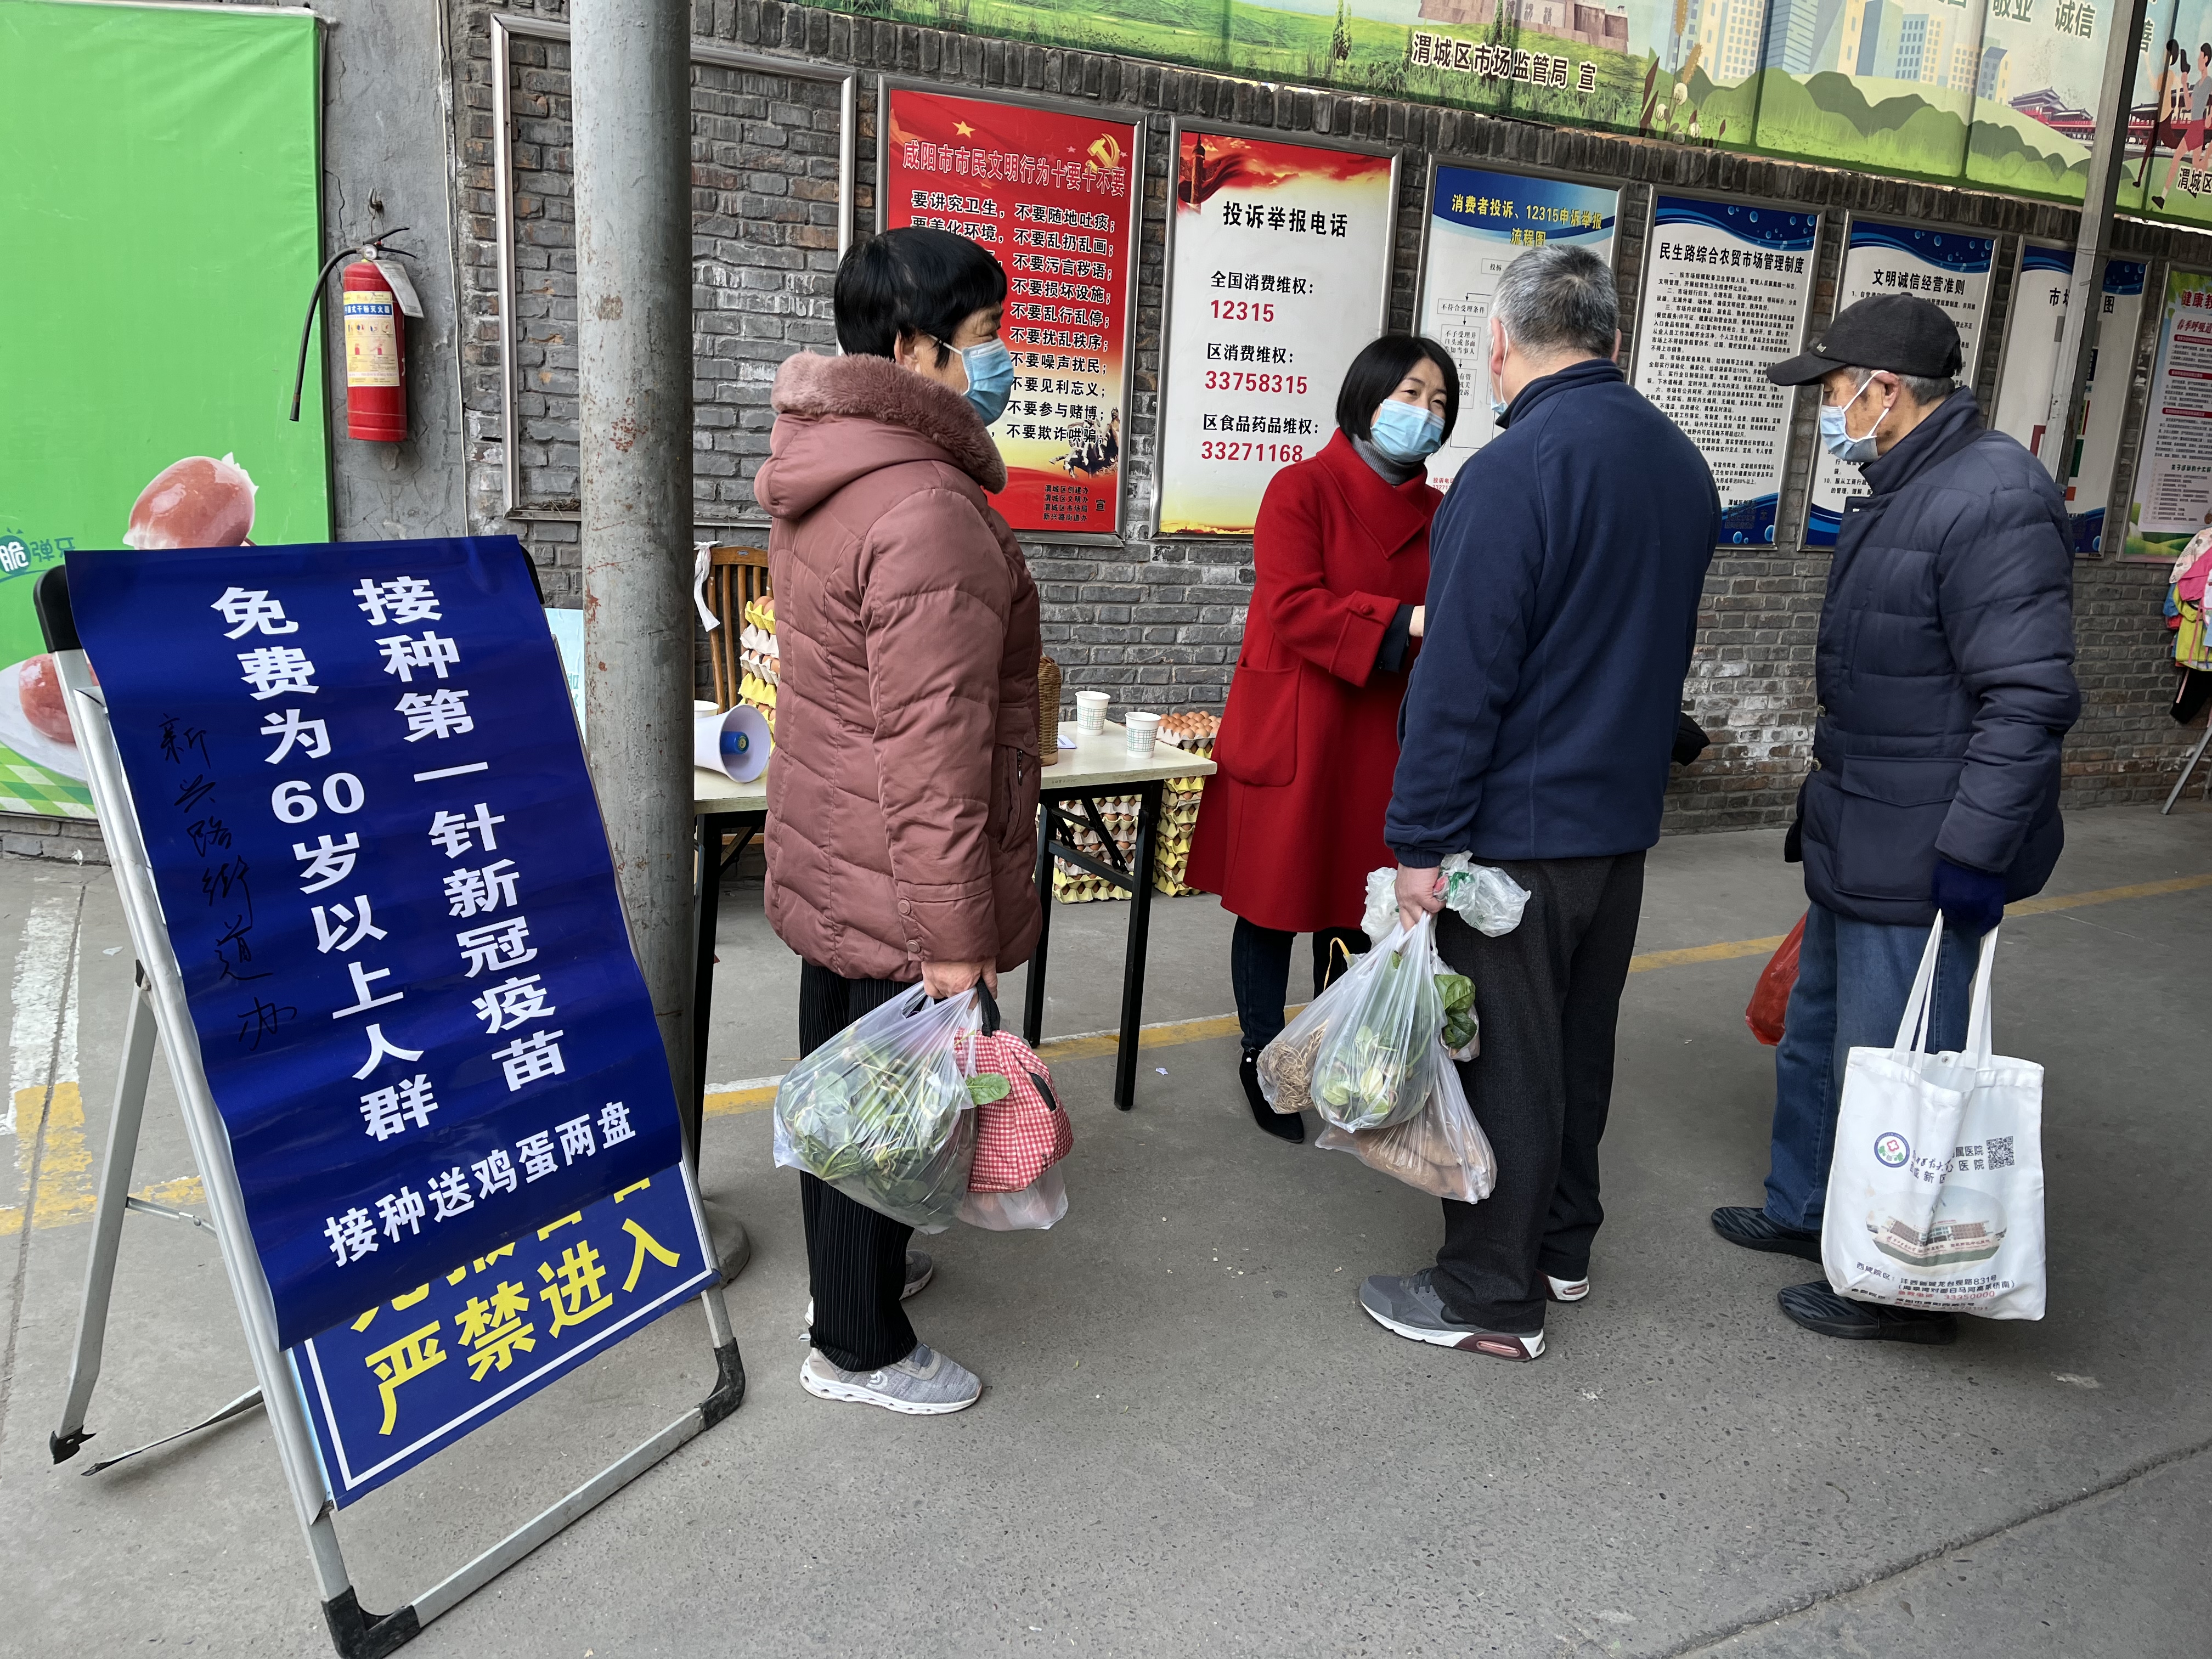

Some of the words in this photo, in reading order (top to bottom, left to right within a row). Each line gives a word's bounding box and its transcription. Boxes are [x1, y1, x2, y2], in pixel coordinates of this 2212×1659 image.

[2055, 0, 2096, 38] 诚信
[1412, 33, 1568, 88] 渭城区市场监管局
[1578, 63, 1597, 92] 宣
[902, 139, 1126, 198] 咸阳市市民文明行为十要十不要
[2177, 167, 2212, 194] 渭城区
[1223, 201, 1348, 238] 投诉举报电话
[1452, 194, 1602, 230] 消费者投诉、12315申诉举报
[1510, 228, 1547, 246] 流程图
[1659, 241, 1805, 274] 民生路综合农贸市场管理制度
[1012, 278, 1111, 304] 不要损坏设施；
[1872, 269, 1965, 295] 文明诚信经营准则
[1211, 300, 1274, 323] 12315
[2103, 295, 2115, 314] 图
[2181, 290, 2212, 309] 健康教
[1009, 303, 1109, 328] 不要乱行乱停；
[1009, 327, 1108, 351] 不要扰乱秩序；
[1010, 351, 1107, 374] 不要噪声扰民；
[1012, 376, 1105, 398] 不要见利忘义；
[1205, 371, 1307, 394] 33758315
[1008, 399, 1104, 421] 不要参与赌博；
[1201, 442, 1303, 463] 33271168
[1045, 485, 1088, 494] 渭城区创建办
[1045, 494, 1088, 503] 渭城区文明办
[1043, 512, 1087, 522] 新兴路街道办
[1044, 503, 1088, 512] 渭城区市场局
[1095, 499, 1105, 511] 宣
[353, 577, 566, 1092] 接种第一针新冠疫苗
[211, 586, 438, 1142] 免费为60岁以上人群
[158, 713, 297, 1052] 新兴路街道办
[324, 1101, 636, 1268] 接种送鸡蛋两盘
[364, 1218, 680, 1436] 严禁进入
